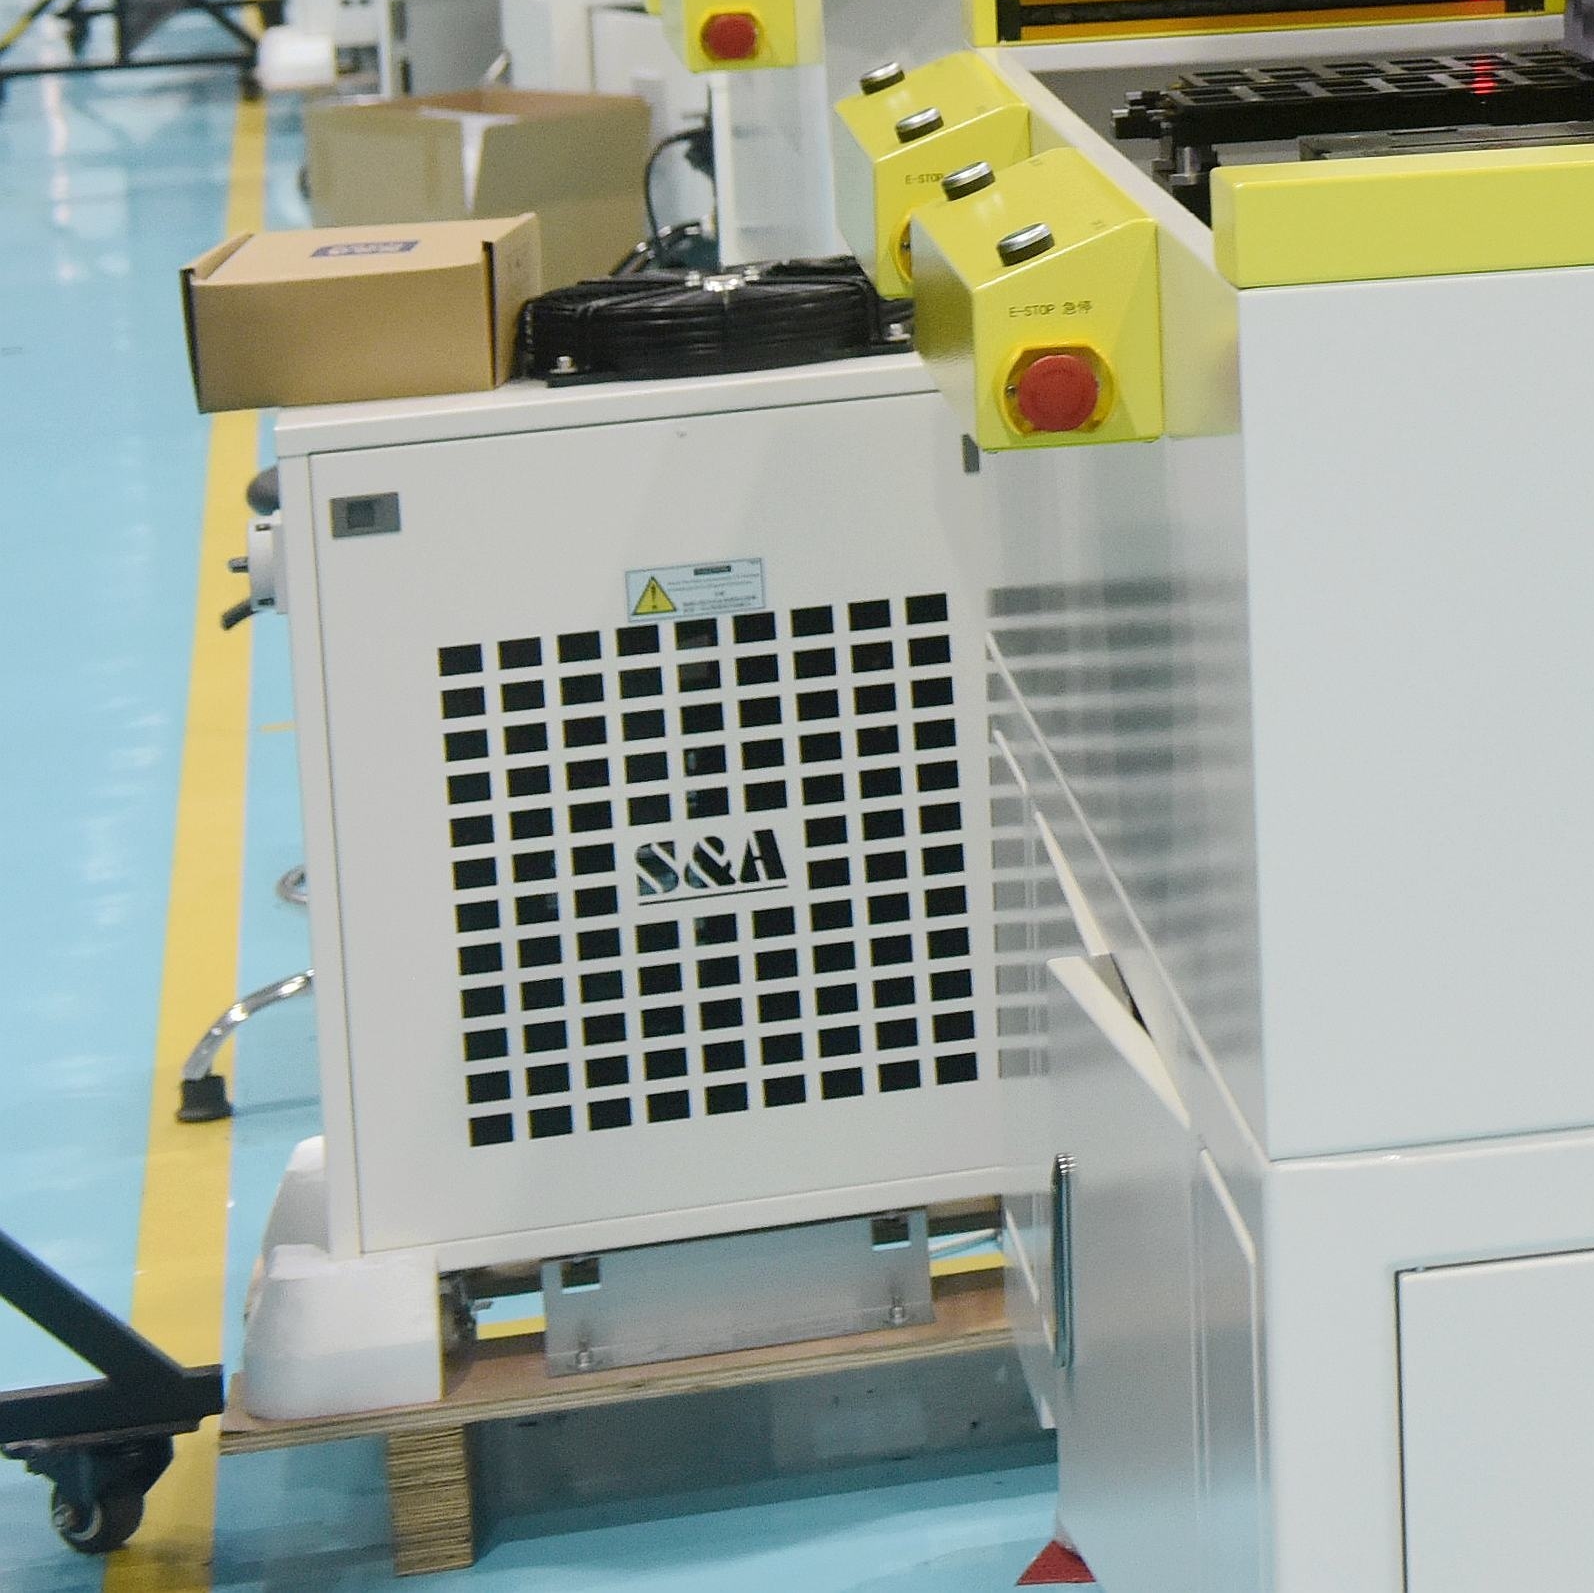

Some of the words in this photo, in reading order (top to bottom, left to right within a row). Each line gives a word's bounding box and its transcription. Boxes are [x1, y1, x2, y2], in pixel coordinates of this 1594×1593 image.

[1009, 304, 1055, 317] E-STOP
[1063, 300, 1093, 316] 急停
[635, 829, 787, 896] S&A
